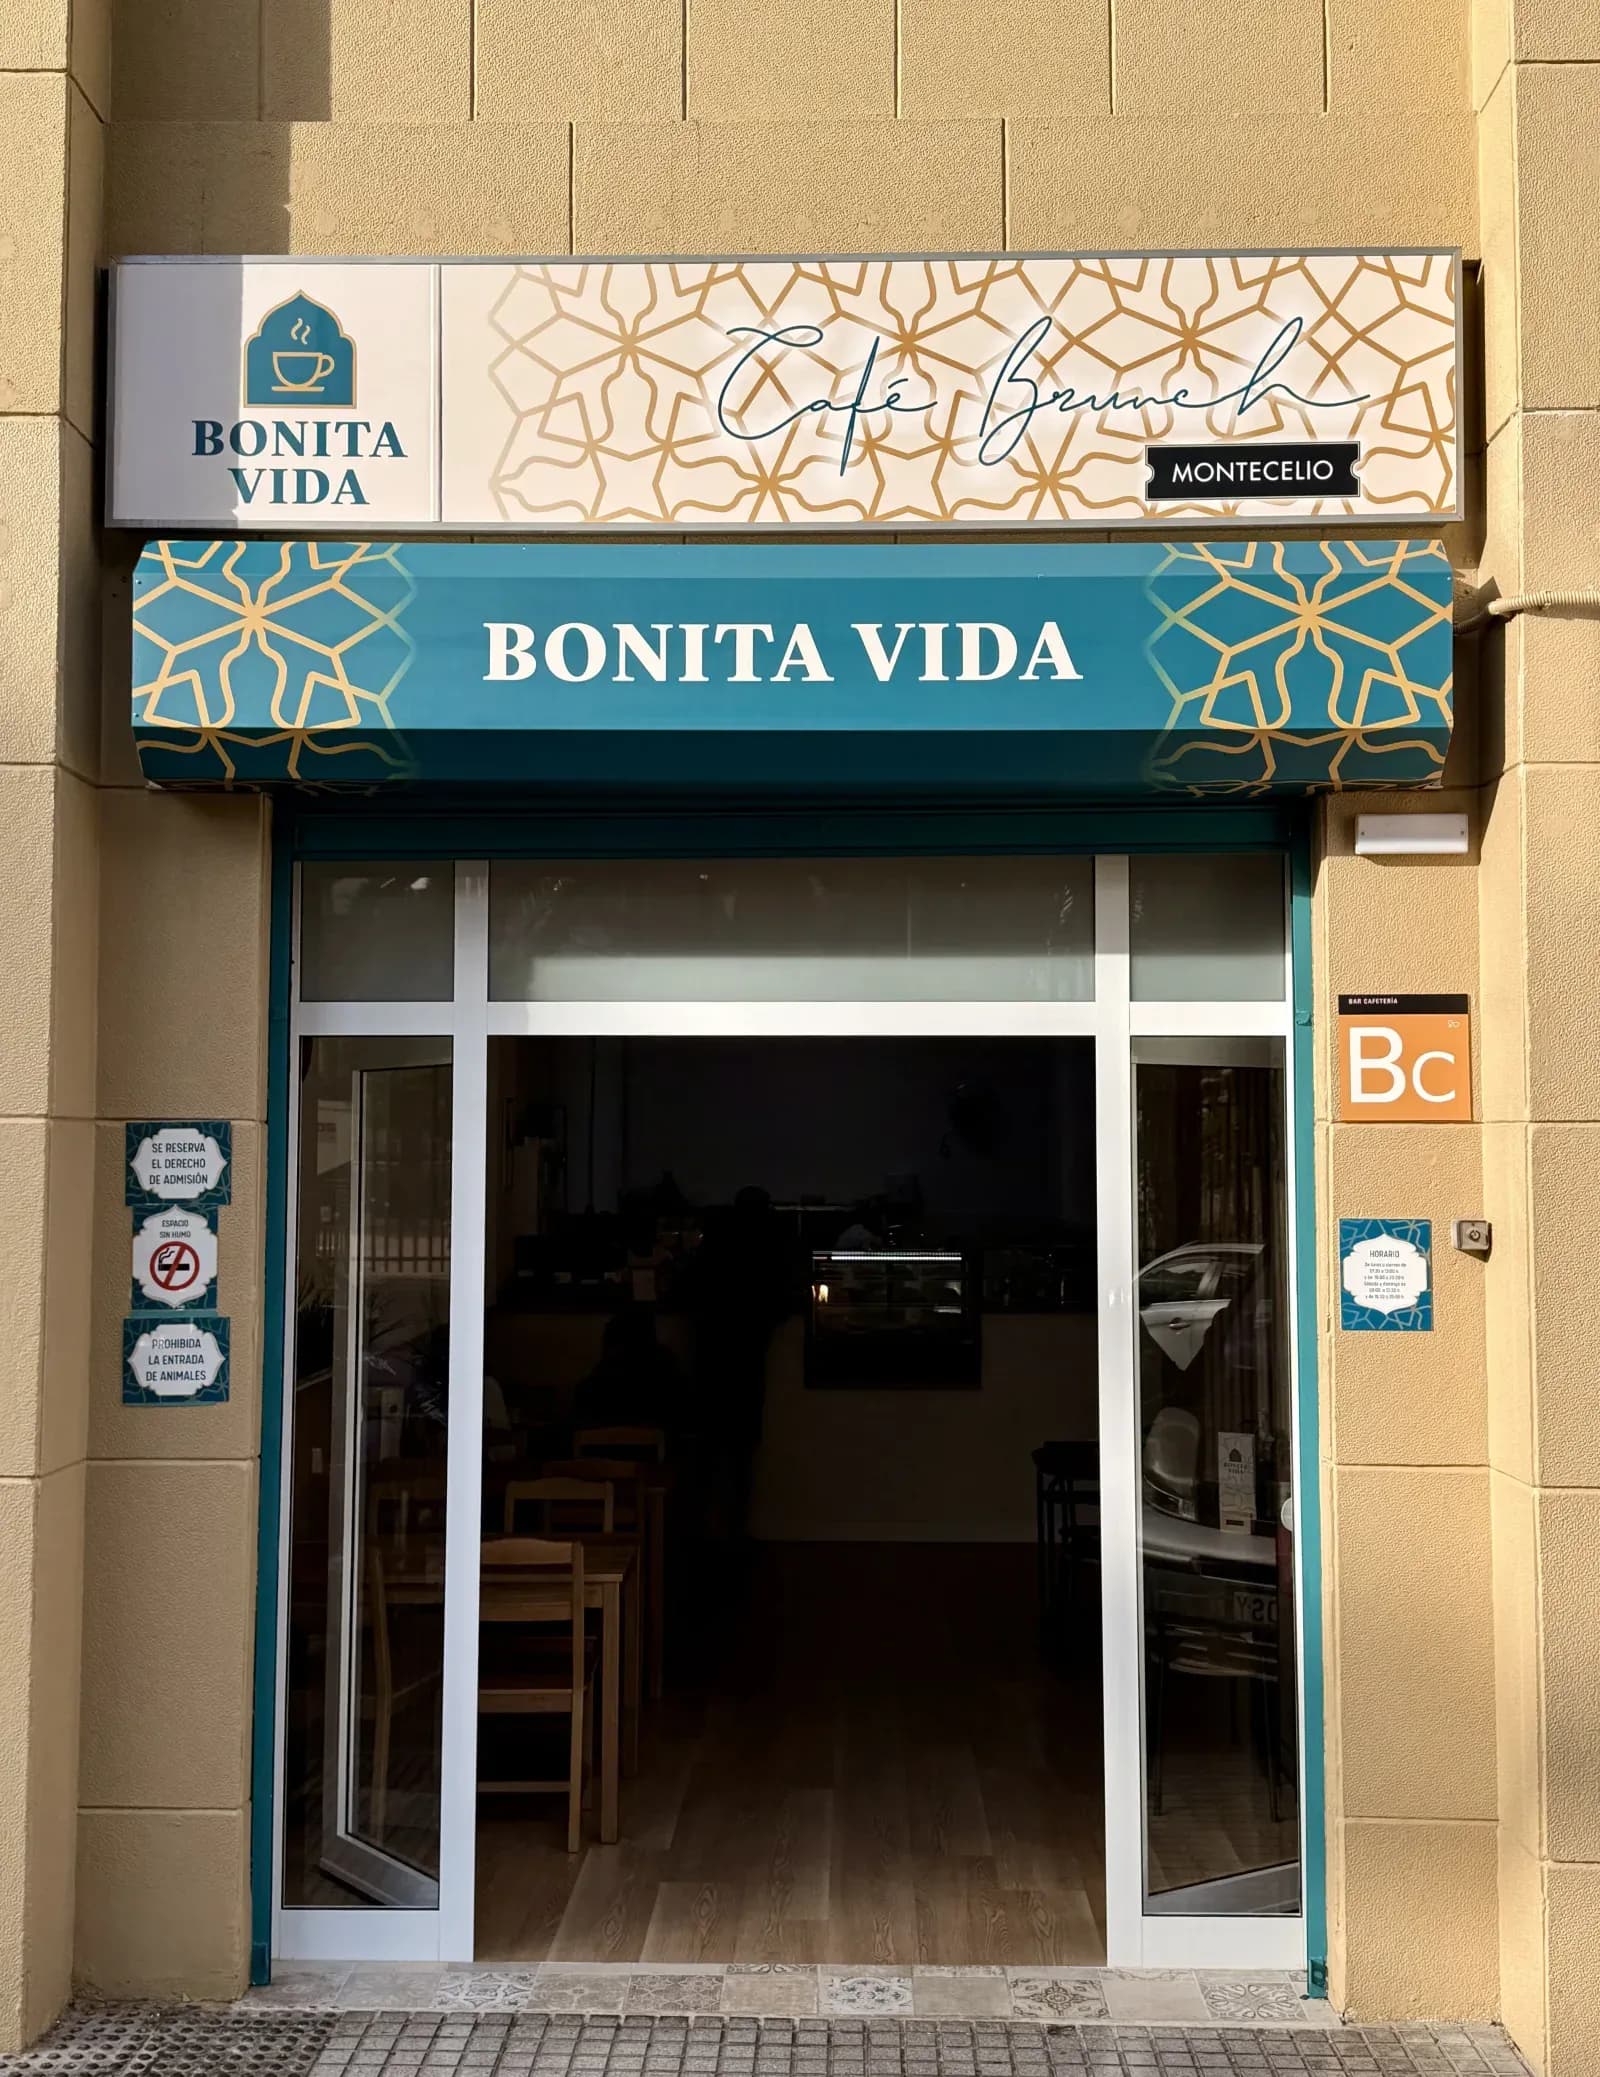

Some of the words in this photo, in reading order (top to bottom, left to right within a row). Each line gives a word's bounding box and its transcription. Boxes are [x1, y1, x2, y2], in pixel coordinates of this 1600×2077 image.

[717, 323, 939, 477] Café
[978, 316, 1371, 467] Brunch
[191, 420, 408, 459] BONITA
[1171, 459, 1335, 485] MONTECELIO
[226, 466, 371, 506] VIDA
[482, 622, 834, 683] BONITA
[850, 621, 1084, 682] VIDA
[1363, 997, 1398, 1005] CAFETERÍA
[1349, 1026, 1456, 1103] Bc
[151, 1142, 163, 1153] SE
[165, 1142, 206, 1153] RESERVA
[151, 1158, 162, 1169] EL
[164, 1158, 206, 1169] DERECHO
[149, 1174, 161, 1185] DE
[163, 1173, 208, 1185] ADMISIÓN
[161, 1219, 189, 1228] ESPACIO
[159, 1231, 171, 1239] SIN
[1369, 1250, 1400, 1258] HORARIO
[151, 1338, 201, 1350] PROHIBIDA
[148, 1354, 160, 1366] LA
[162, 1354, 204, 1365] ENTRADA
[145, 1371, 157, 1382] DE
[160, 1370, 207, 1381] ANIMALES
